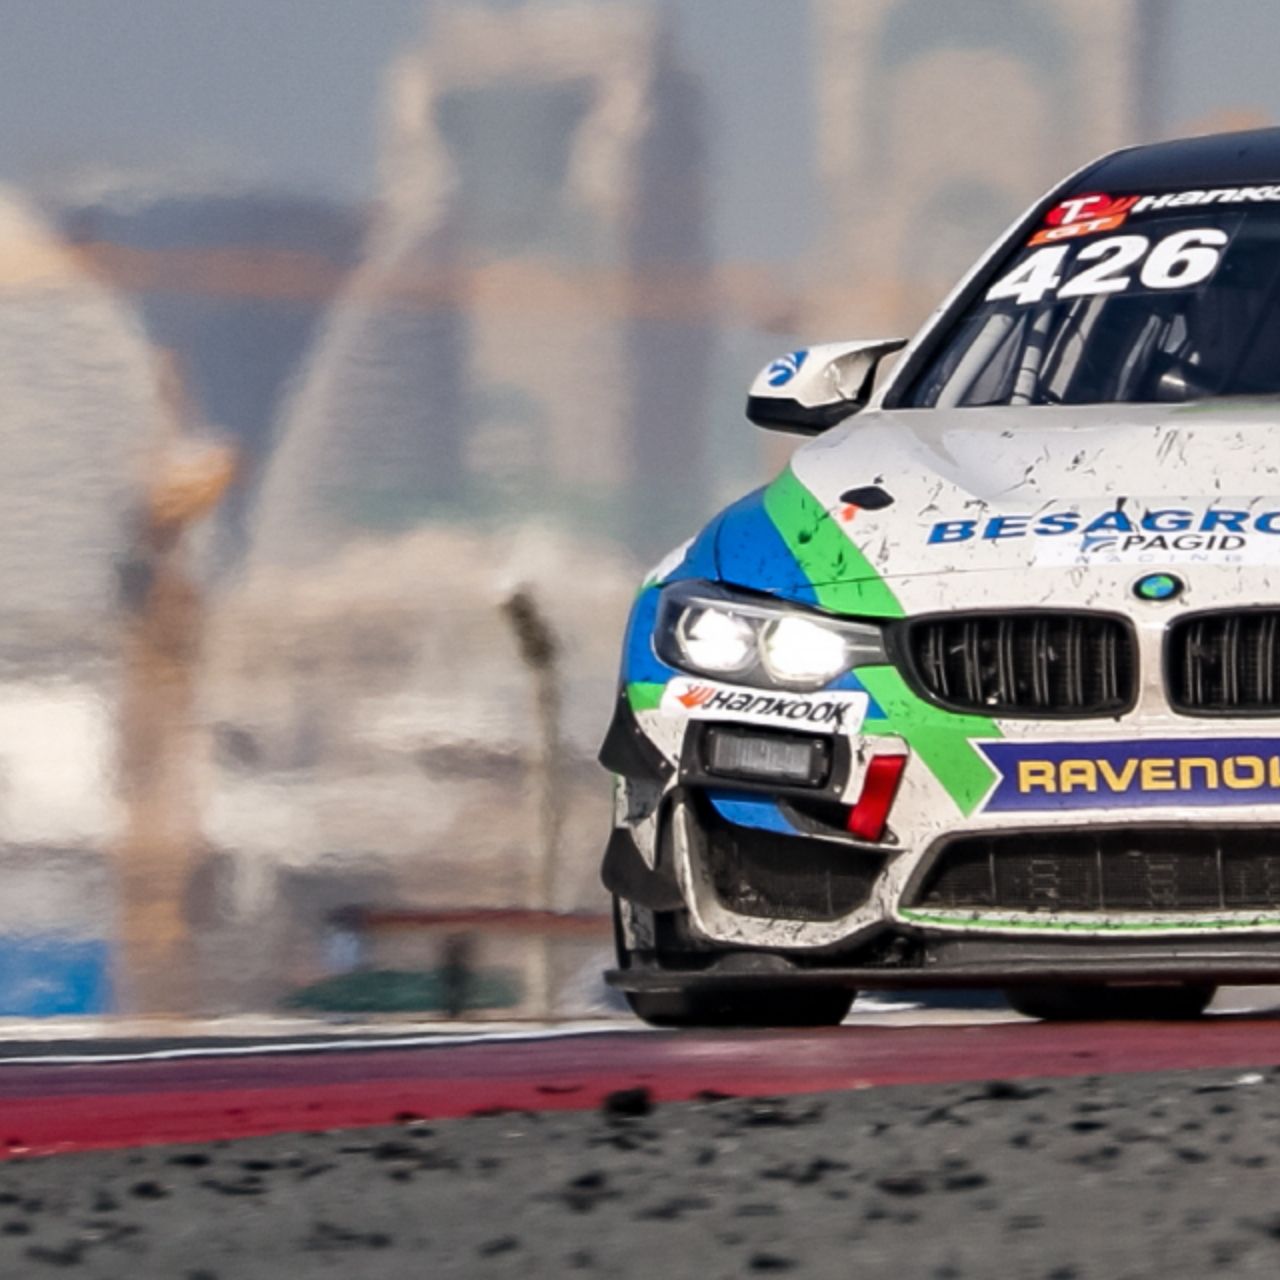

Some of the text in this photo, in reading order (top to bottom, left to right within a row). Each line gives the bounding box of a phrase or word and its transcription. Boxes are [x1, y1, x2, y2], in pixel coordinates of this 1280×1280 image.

[984, 228, 1229, 305] 426
[1121, 534, 1246, 552] PAGID
[703, 689, 852, 724] HANKOOK
